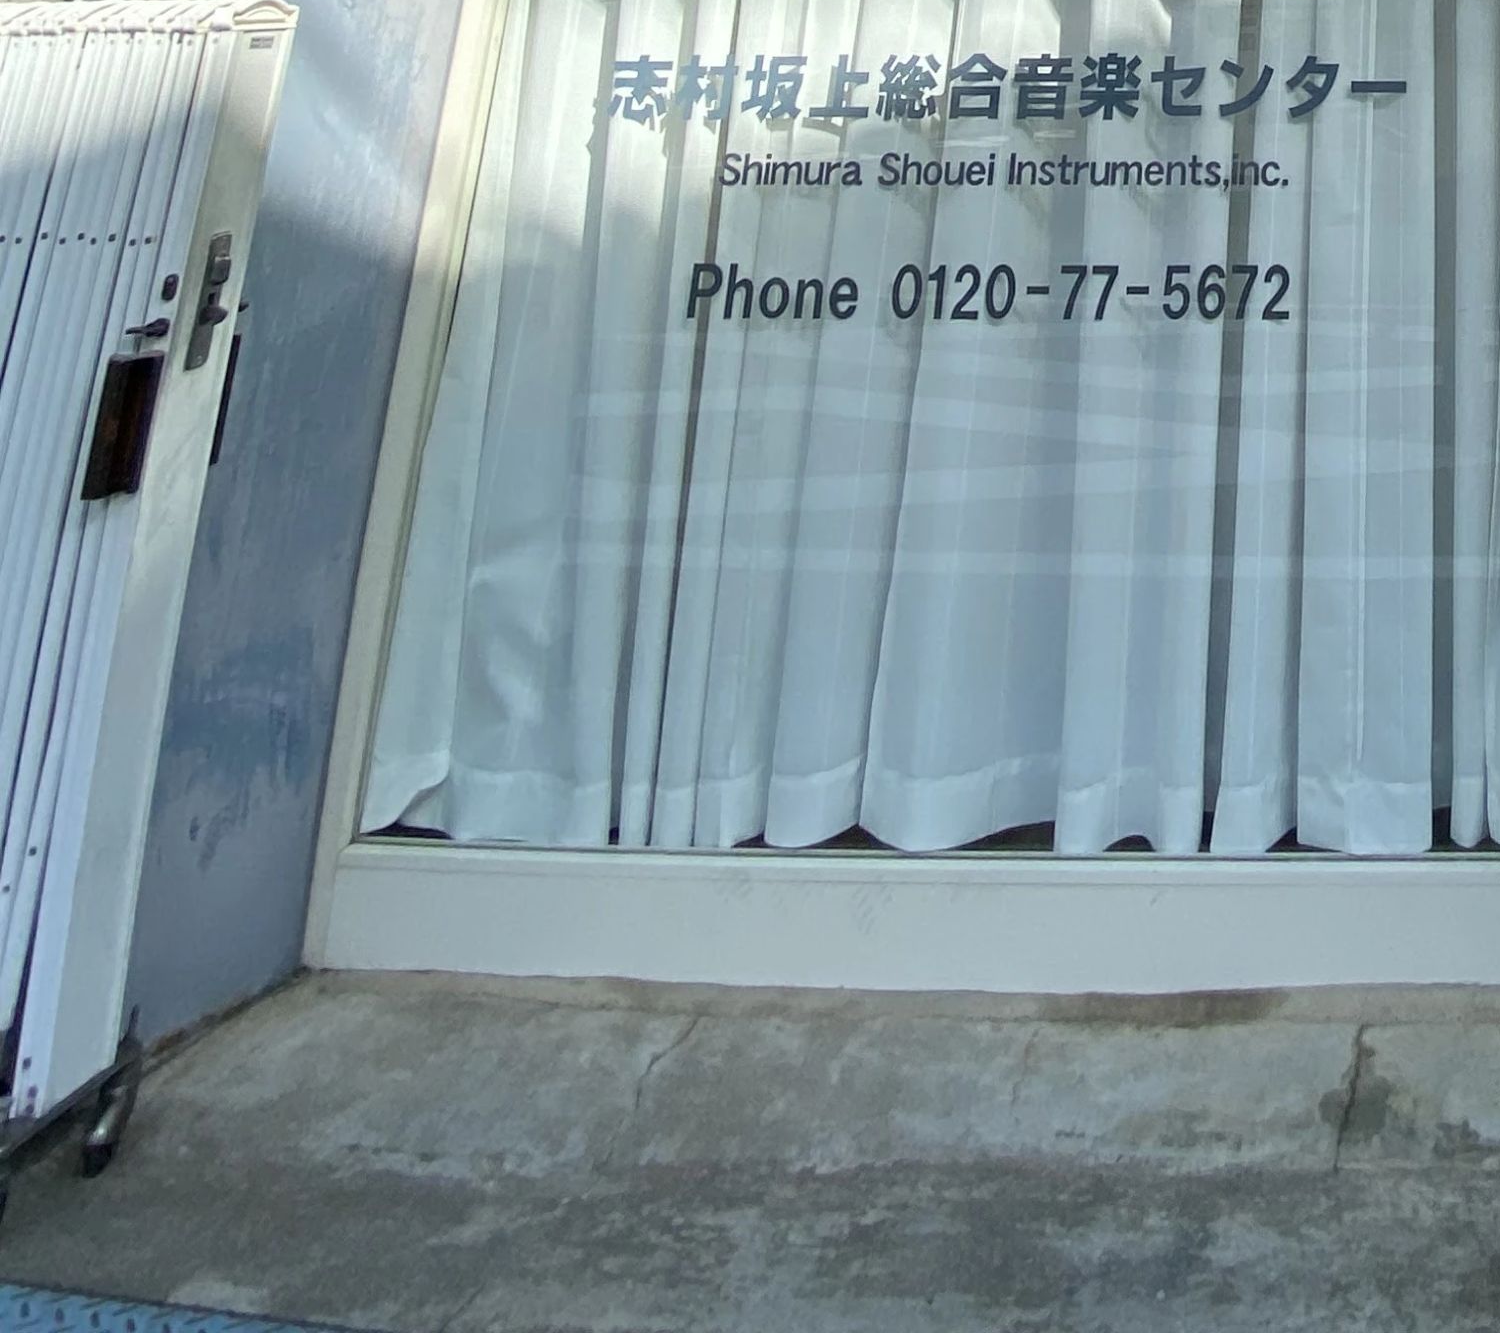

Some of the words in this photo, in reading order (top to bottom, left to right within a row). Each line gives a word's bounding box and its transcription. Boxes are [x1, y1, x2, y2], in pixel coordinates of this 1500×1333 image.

[607, 52, 1408, 123] 志村坂上総合音楽センター
[718, 151, 862, 188] Shimura
[877, 151, 995, 188] Shouei
[686, 263, 859, 321] Phone
[891, 263, 1291, 321] 0120-77-5672
